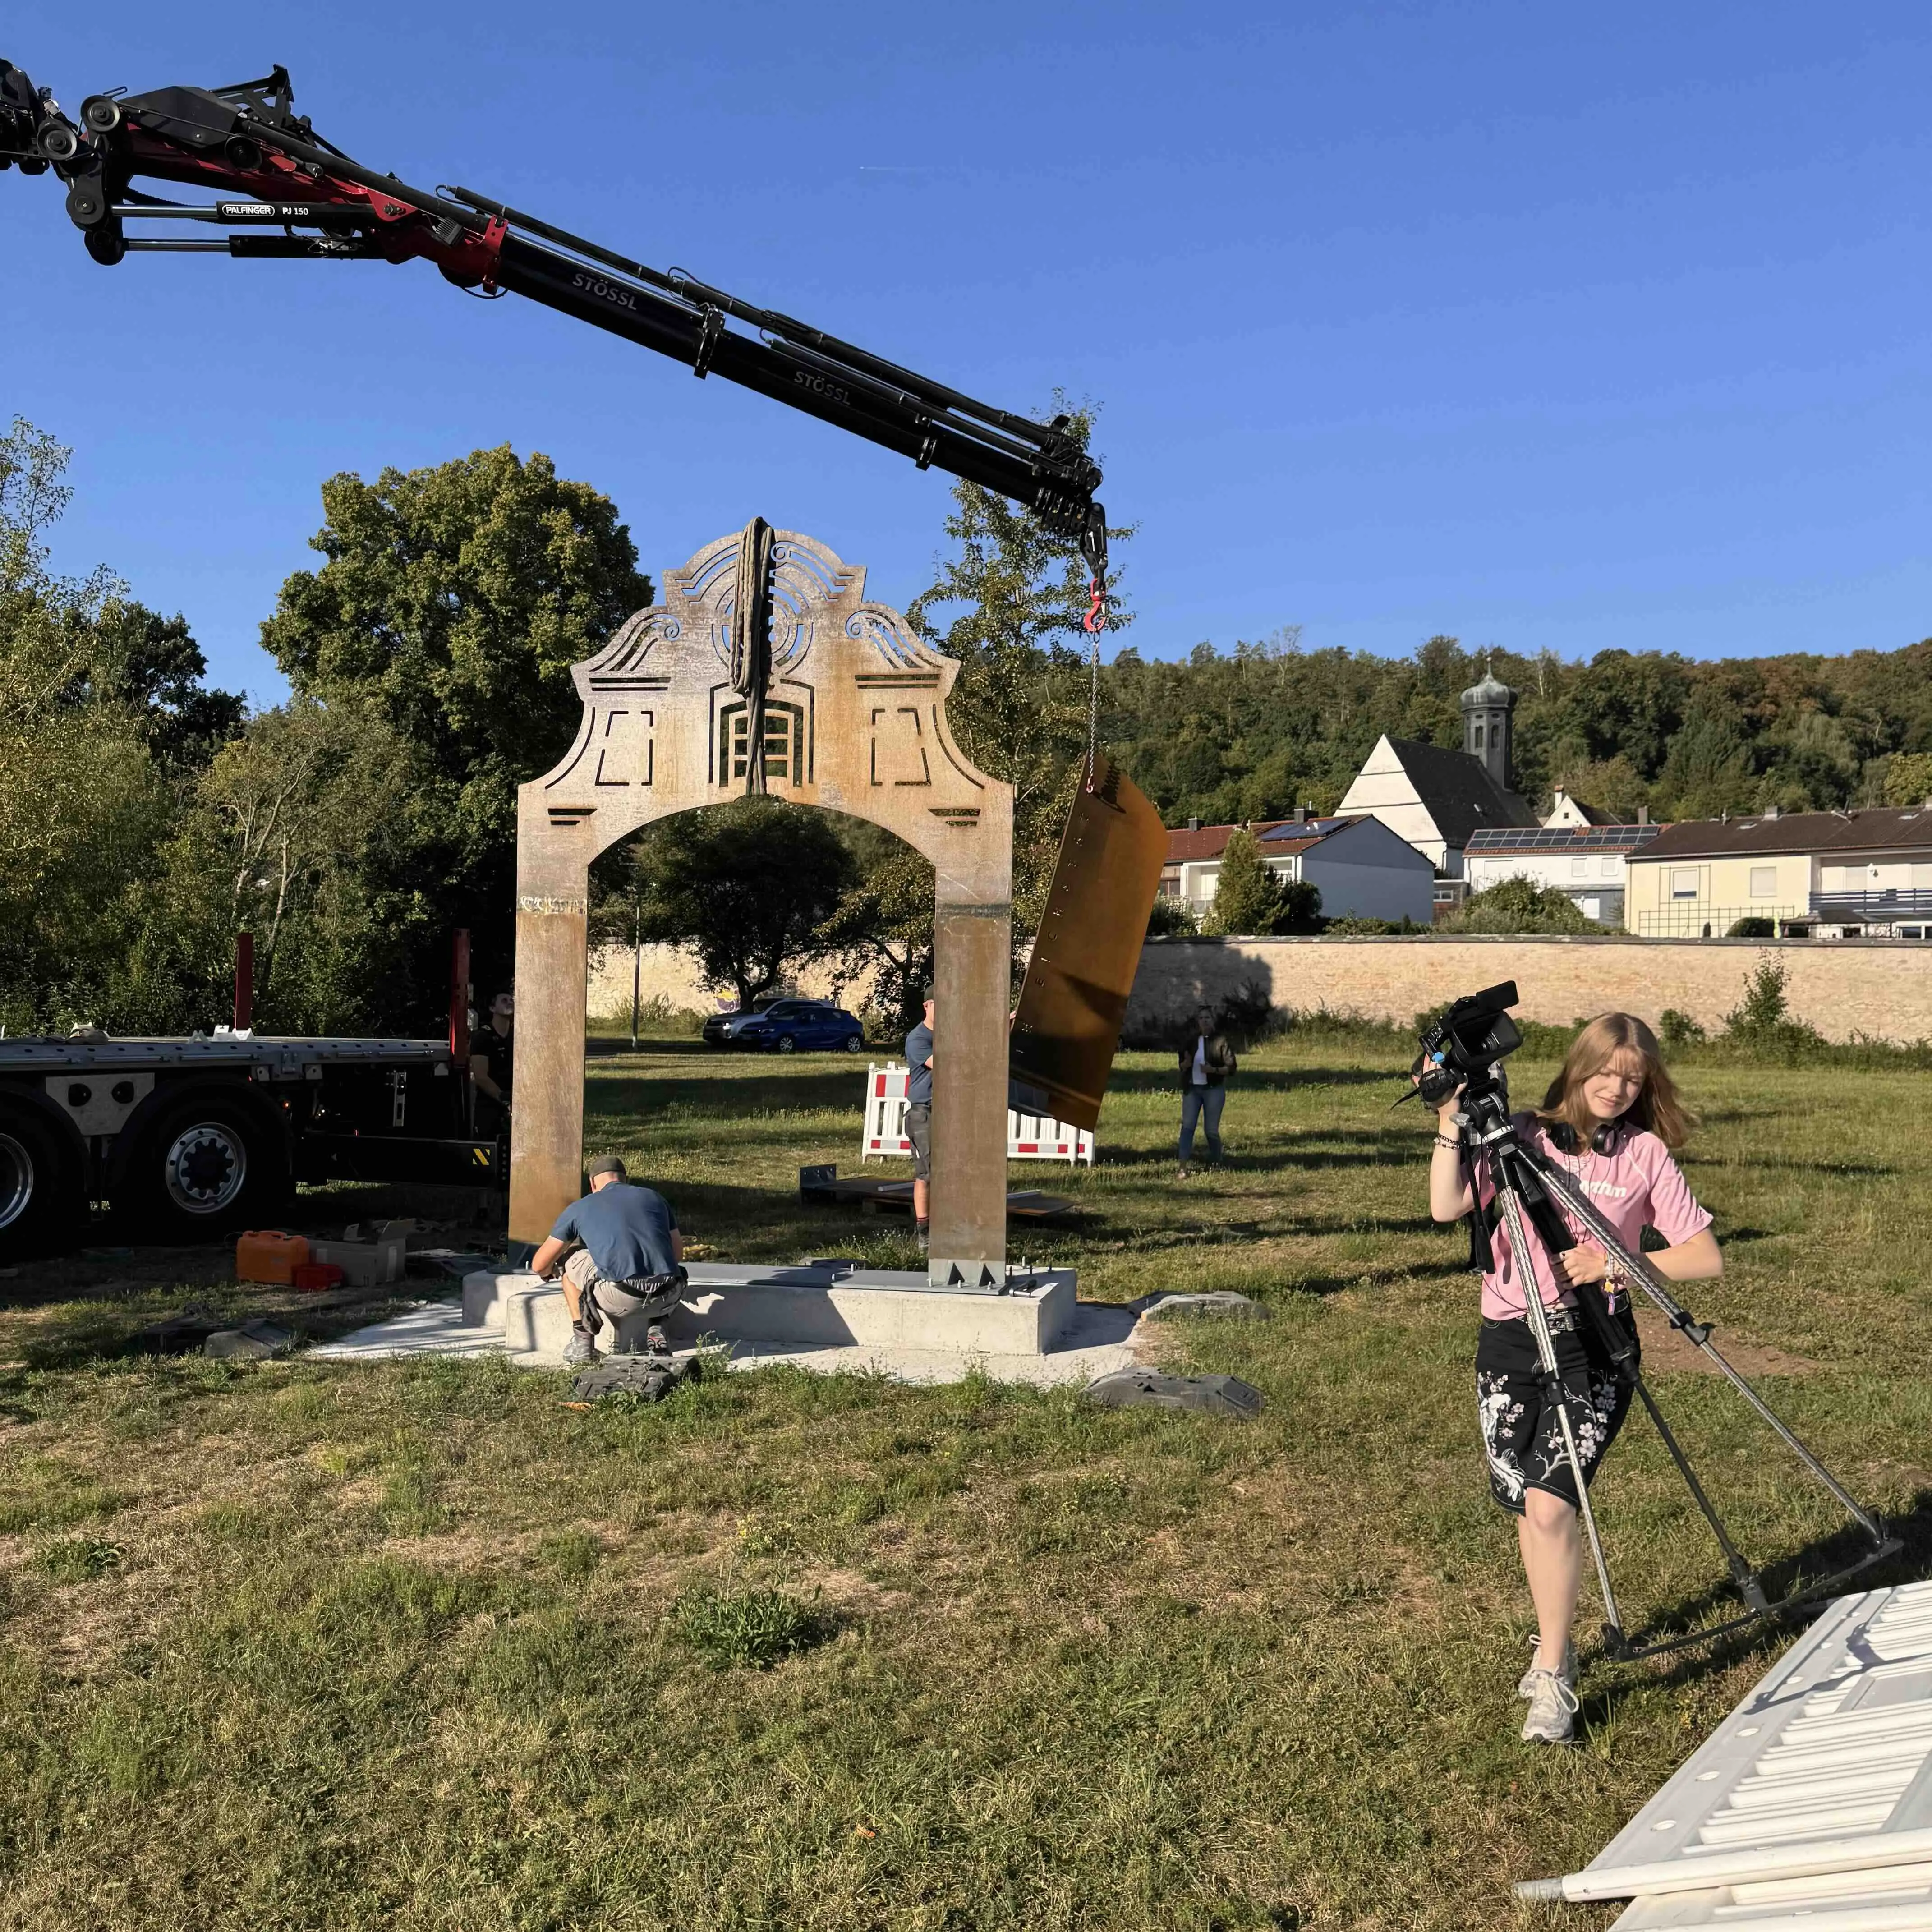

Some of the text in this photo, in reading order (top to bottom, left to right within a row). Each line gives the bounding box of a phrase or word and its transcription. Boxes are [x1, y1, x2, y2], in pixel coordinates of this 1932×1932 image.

[226, 206, 271, 214] PALFINGER
[572, 273, 637, 310] STÖSSL
[794, 371, 851, 405] STÖSSL
